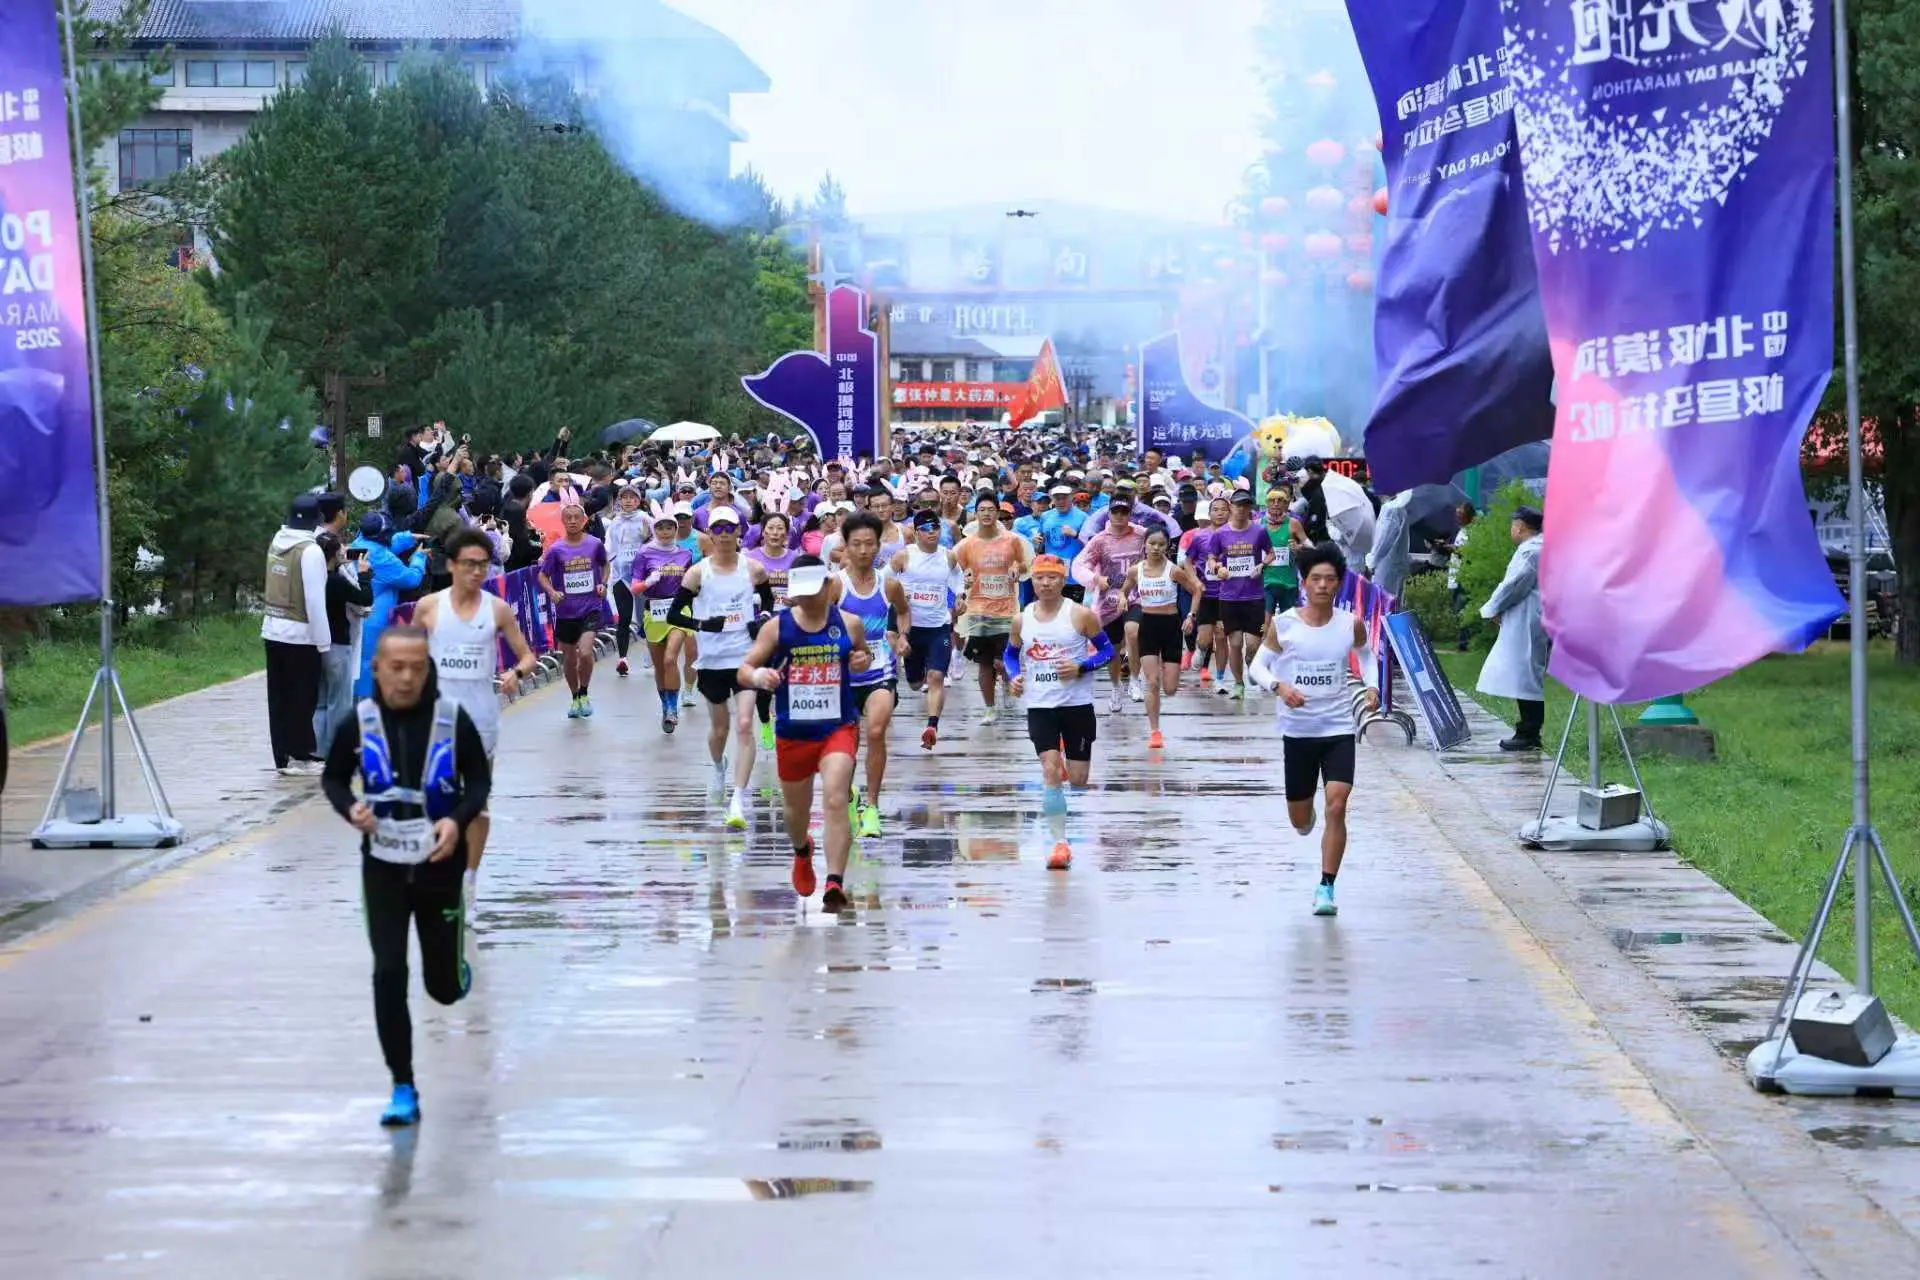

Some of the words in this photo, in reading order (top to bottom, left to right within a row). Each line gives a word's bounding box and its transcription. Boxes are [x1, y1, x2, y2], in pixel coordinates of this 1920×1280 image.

[955, 305, 1034, 330] HOTEL
[836, 353, 857, 362] 中国
[440, 657, 478, 669] A0001
[1035, 672, 1058, 682] A009
[1294, 675, 1332, 686] A0055
[791, 699, 829, 710] A0041
